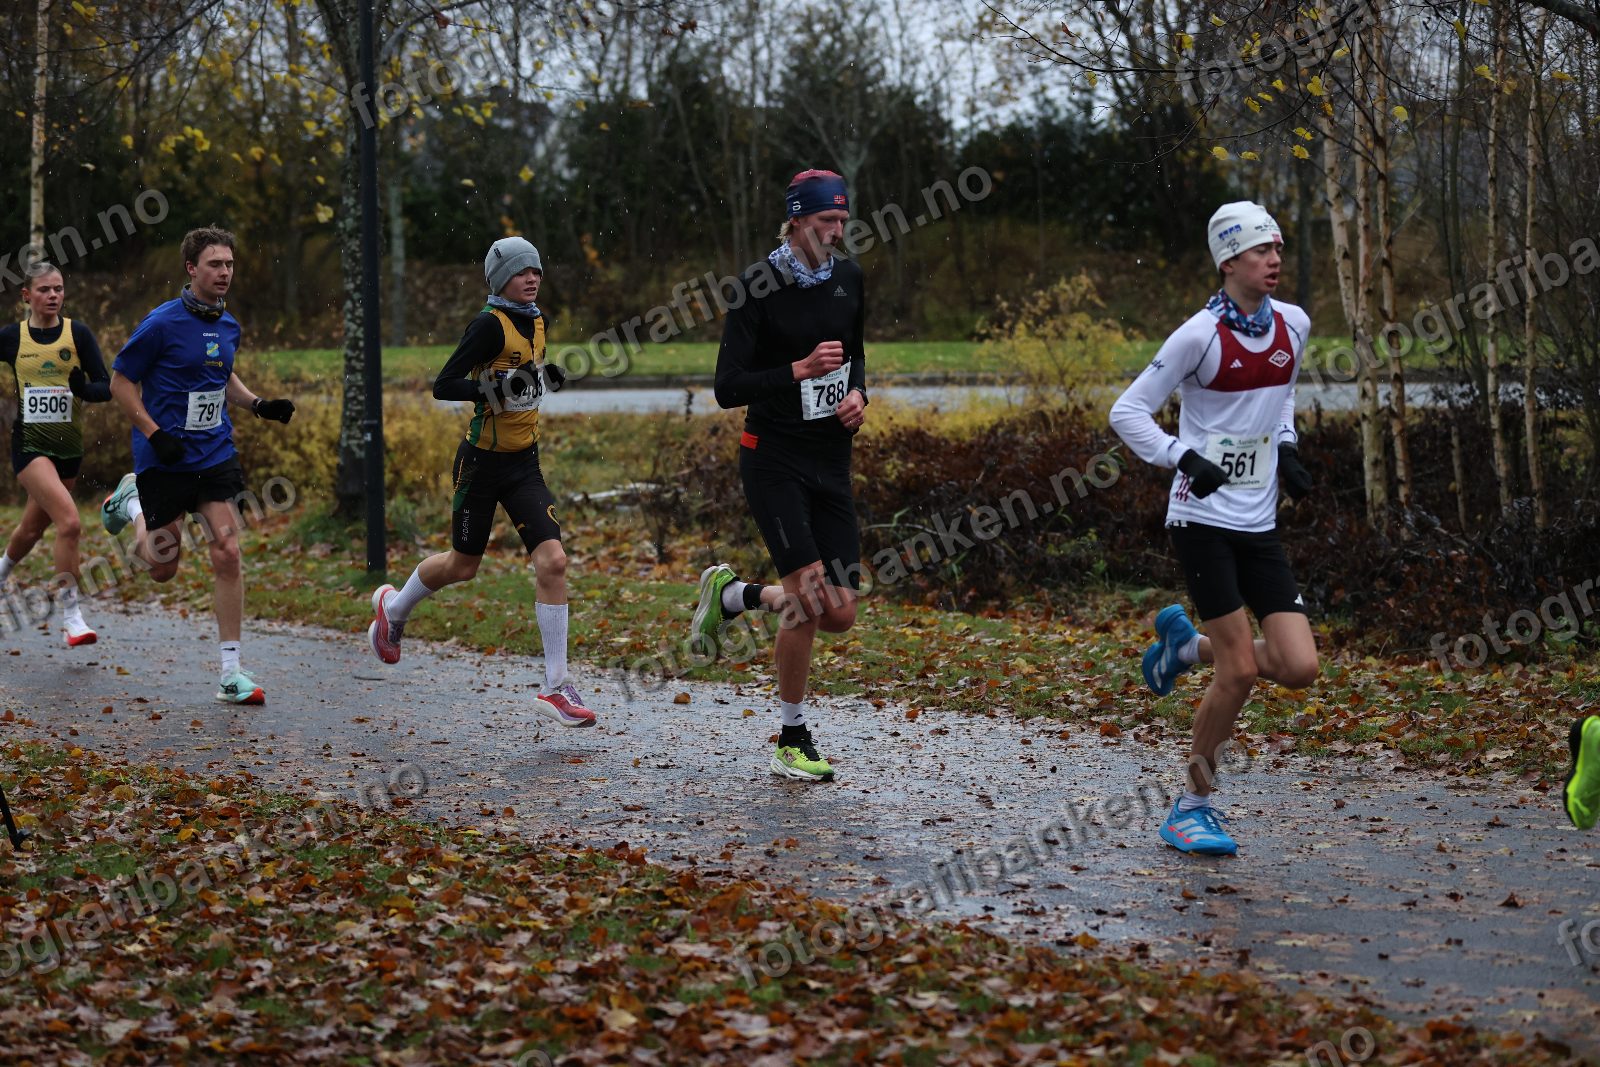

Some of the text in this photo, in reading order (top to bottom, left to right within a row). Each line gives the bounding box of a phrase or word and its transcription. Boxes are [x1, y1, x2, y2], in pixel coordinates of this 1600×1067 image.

[28, 396, 68, 414] 9506
[813, 380, 845, 408] 788
[198, 401, 220, 422] 791
[1221, 450, 1256, 478] 561
